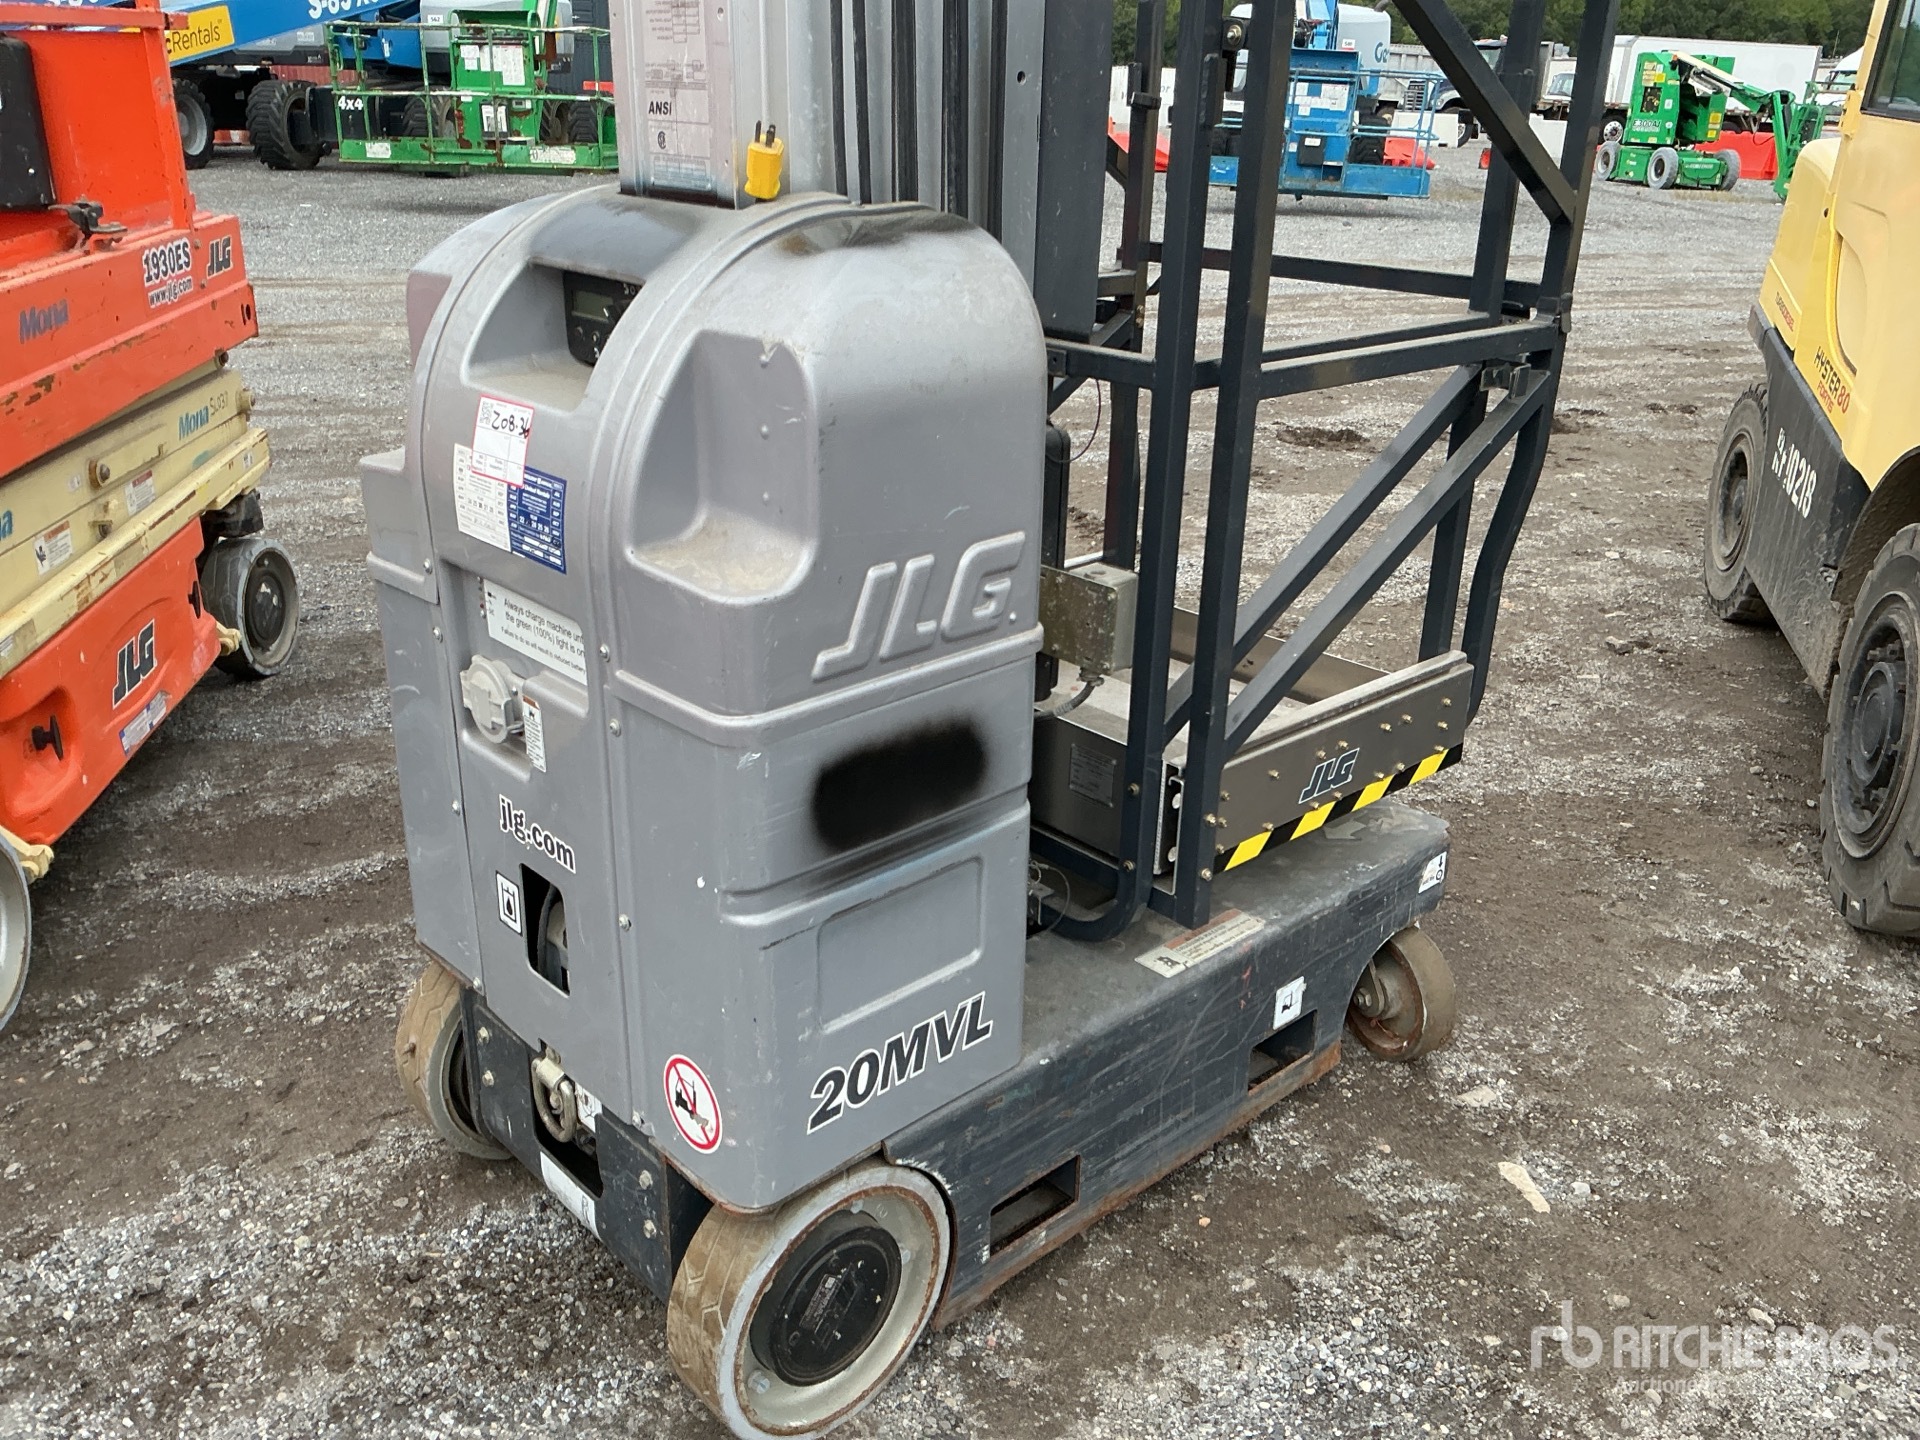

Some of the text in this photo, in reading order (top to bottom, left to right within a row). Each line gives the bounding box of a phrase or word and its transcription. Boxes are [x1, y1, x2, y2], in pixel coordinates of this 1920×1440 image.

[338, 96, 364, 110] 4x4
[648, 101, 672, 116] ANSI
[143, 240, 191, 283] 1930ES
[206, 236, 233, 278] JLG
[149, 278, 192, 306] www.jlg.com
[19, 298, 69, 345] Mona
[1813, 345, 1851, 414] HYSTER 80
[179, 405, 209, 440] Mona
[504, 598, 524, 616] Always
[525, 609, 545, 626] charge
[546, 619, 572, 639] machine
[811, 531, 1026, 684] JLG
[505, 611, 514, 624] the
[516, 617, 532, 631] green
[556, 636, 569, 651] light
[113, 619, 157, 709] JLG
[1298, 747, 1360, 804] JLG
[499, 794, 576, 874] jlg.com
[806, 991, 993, 1135] 20MVL
